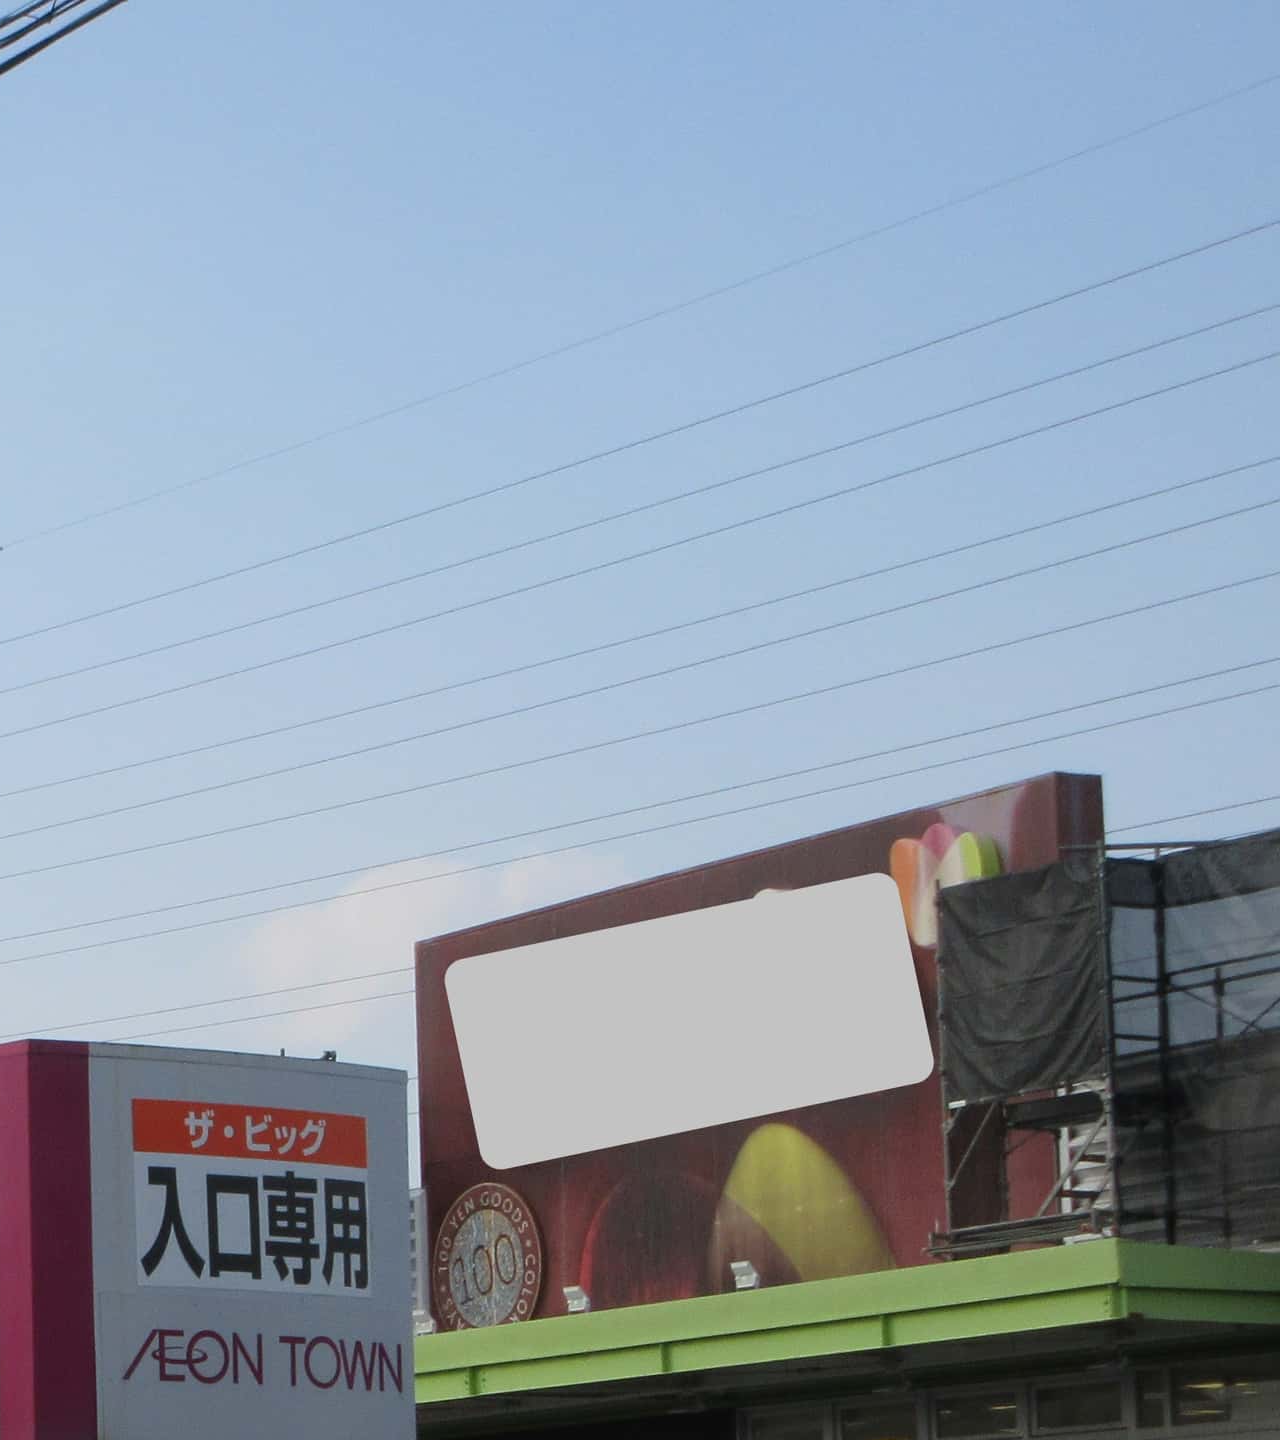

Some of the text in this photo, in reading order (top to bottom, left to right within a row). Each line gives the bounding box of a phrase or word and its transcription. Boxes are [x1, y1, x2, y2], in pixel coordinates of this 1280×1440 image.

[183, 1110, 328, 1157] ザ・ビッグ
[140, 1165, 369, 1290] 入口専用
[479, 1191, 530, 1234] GOODS
[451, 1232, 517, 1306] 100
[278, 1334, 404, 1394] TOWN
